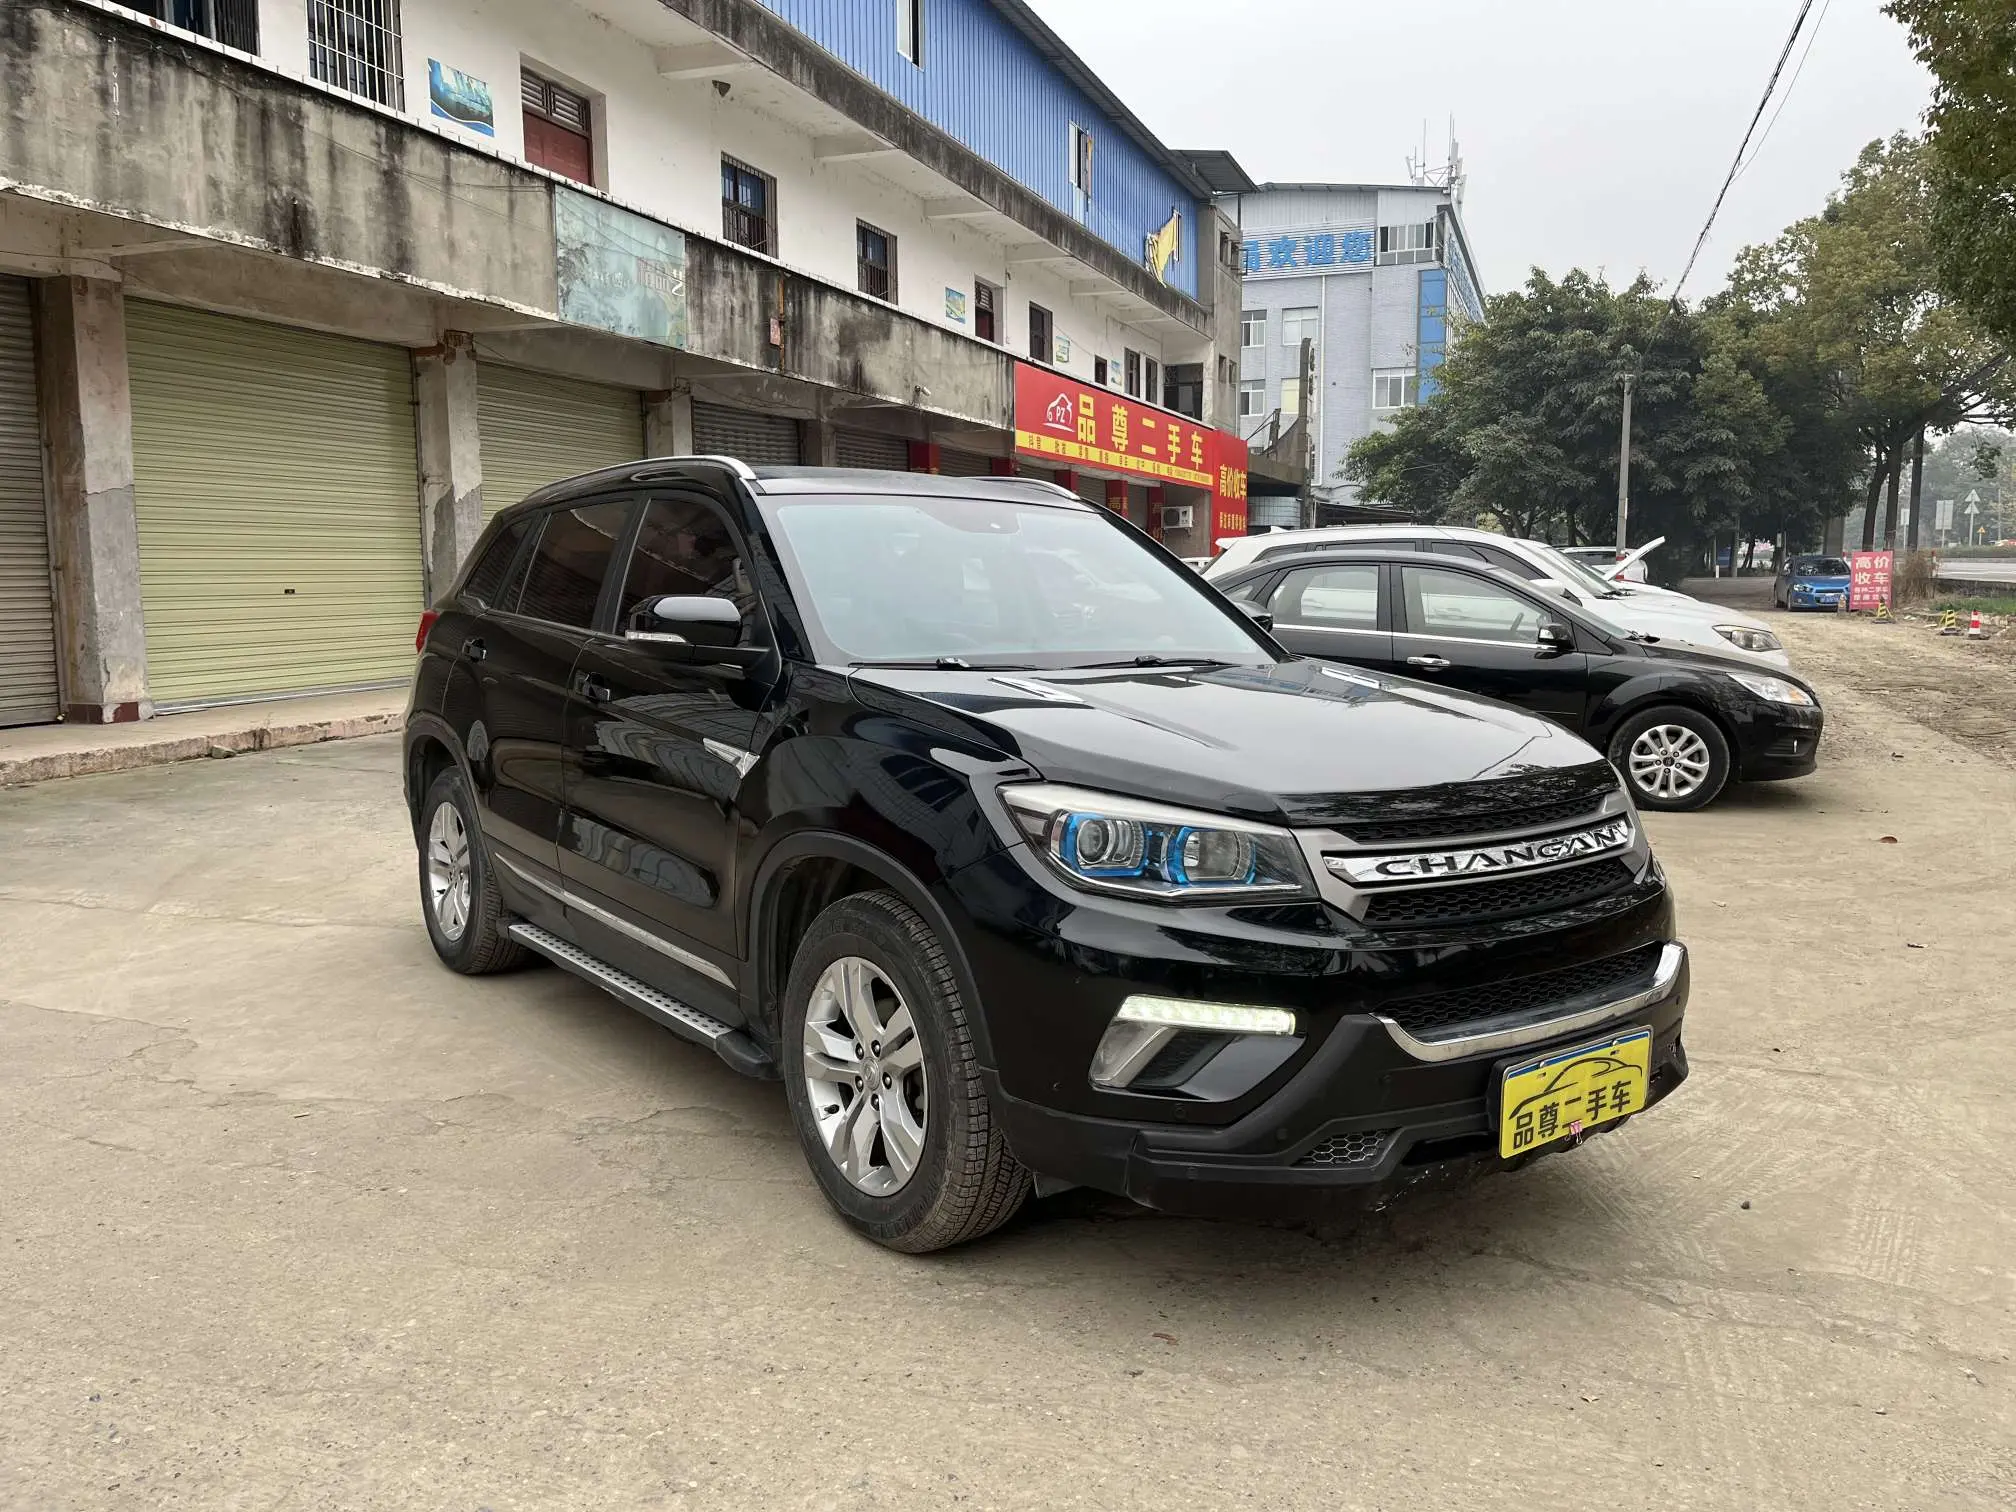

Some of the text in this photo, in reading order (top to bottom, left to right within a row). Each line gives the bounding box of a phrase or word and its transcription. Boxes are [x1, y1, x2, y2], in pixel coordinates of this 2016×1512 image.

[1056, 406, 1066, 423] PZ
[1077, 393, 1204, 470] 品尊二手车
[1219, 464, 1248, 500] 高价收车
[1855, 556, 1890, 569] 高价
[1855, 572, 1889, 585] 收车
[1375, 826, 1621, 877] CHANGAN
[1513, 1080, 1632, 1150] 品尊二手车
